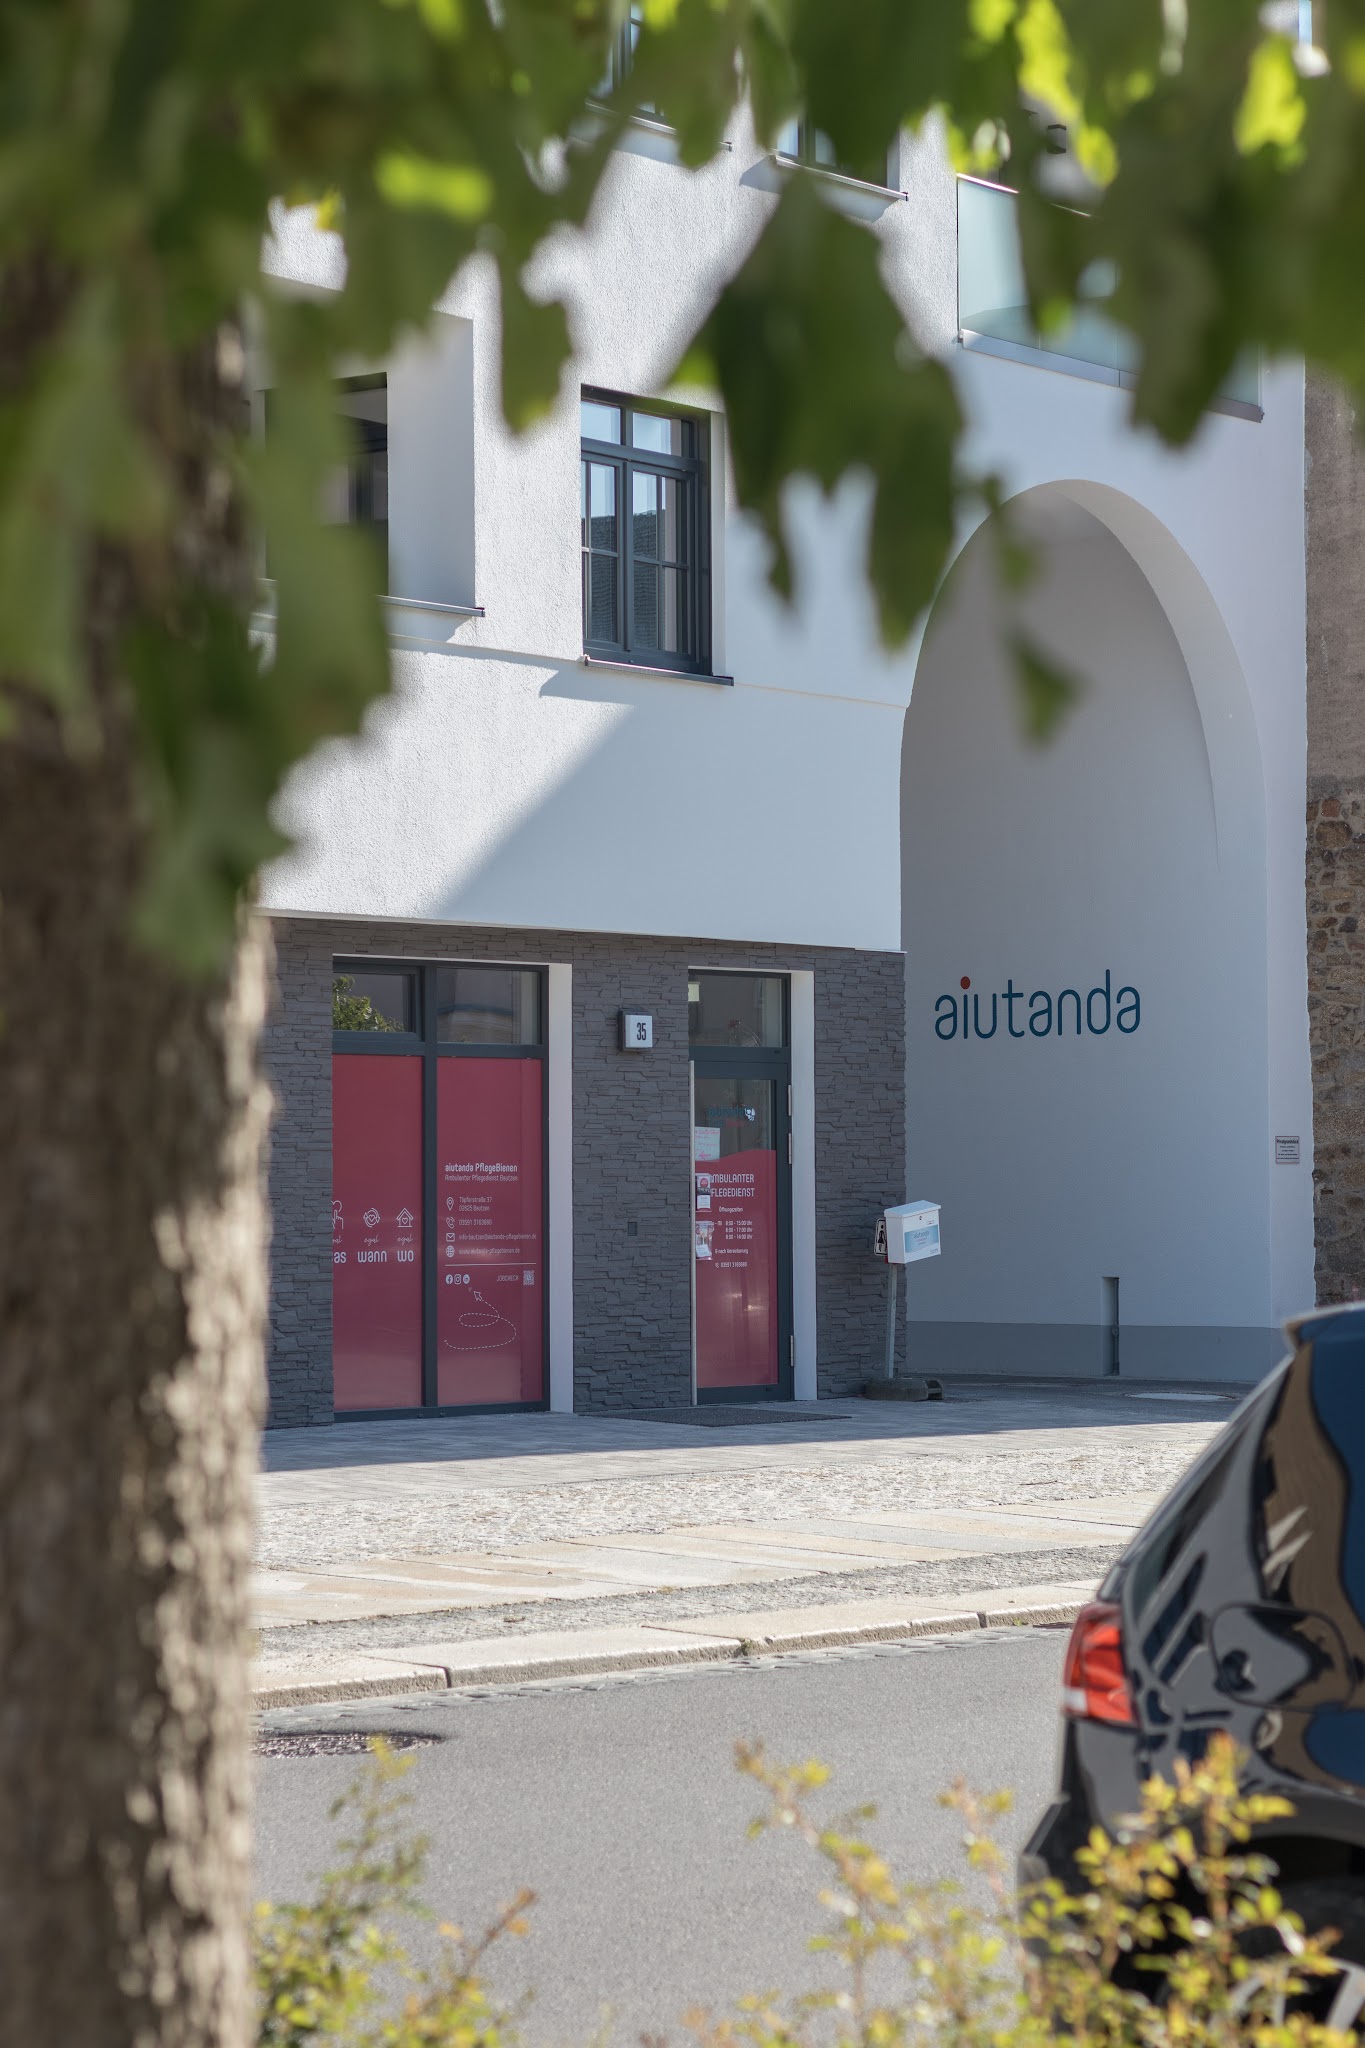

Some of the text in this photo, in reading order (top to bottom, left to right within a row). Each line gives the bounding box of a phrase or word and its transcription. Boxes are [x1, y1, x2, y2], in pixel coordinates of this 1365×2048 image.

[935, 968, 1141, 1041] aiutanda
[636, 1022, 647, 1041] 35
[445, 1163, 518, 1174] aiutanda PflegeBienen
[472, 1174, 499, 1182] Pflegedienst
[363, 1234, 380, 1247] egal
[397, 1233, 414, 1246] egal
[333, 1250, 414, 1264] as wann wo
